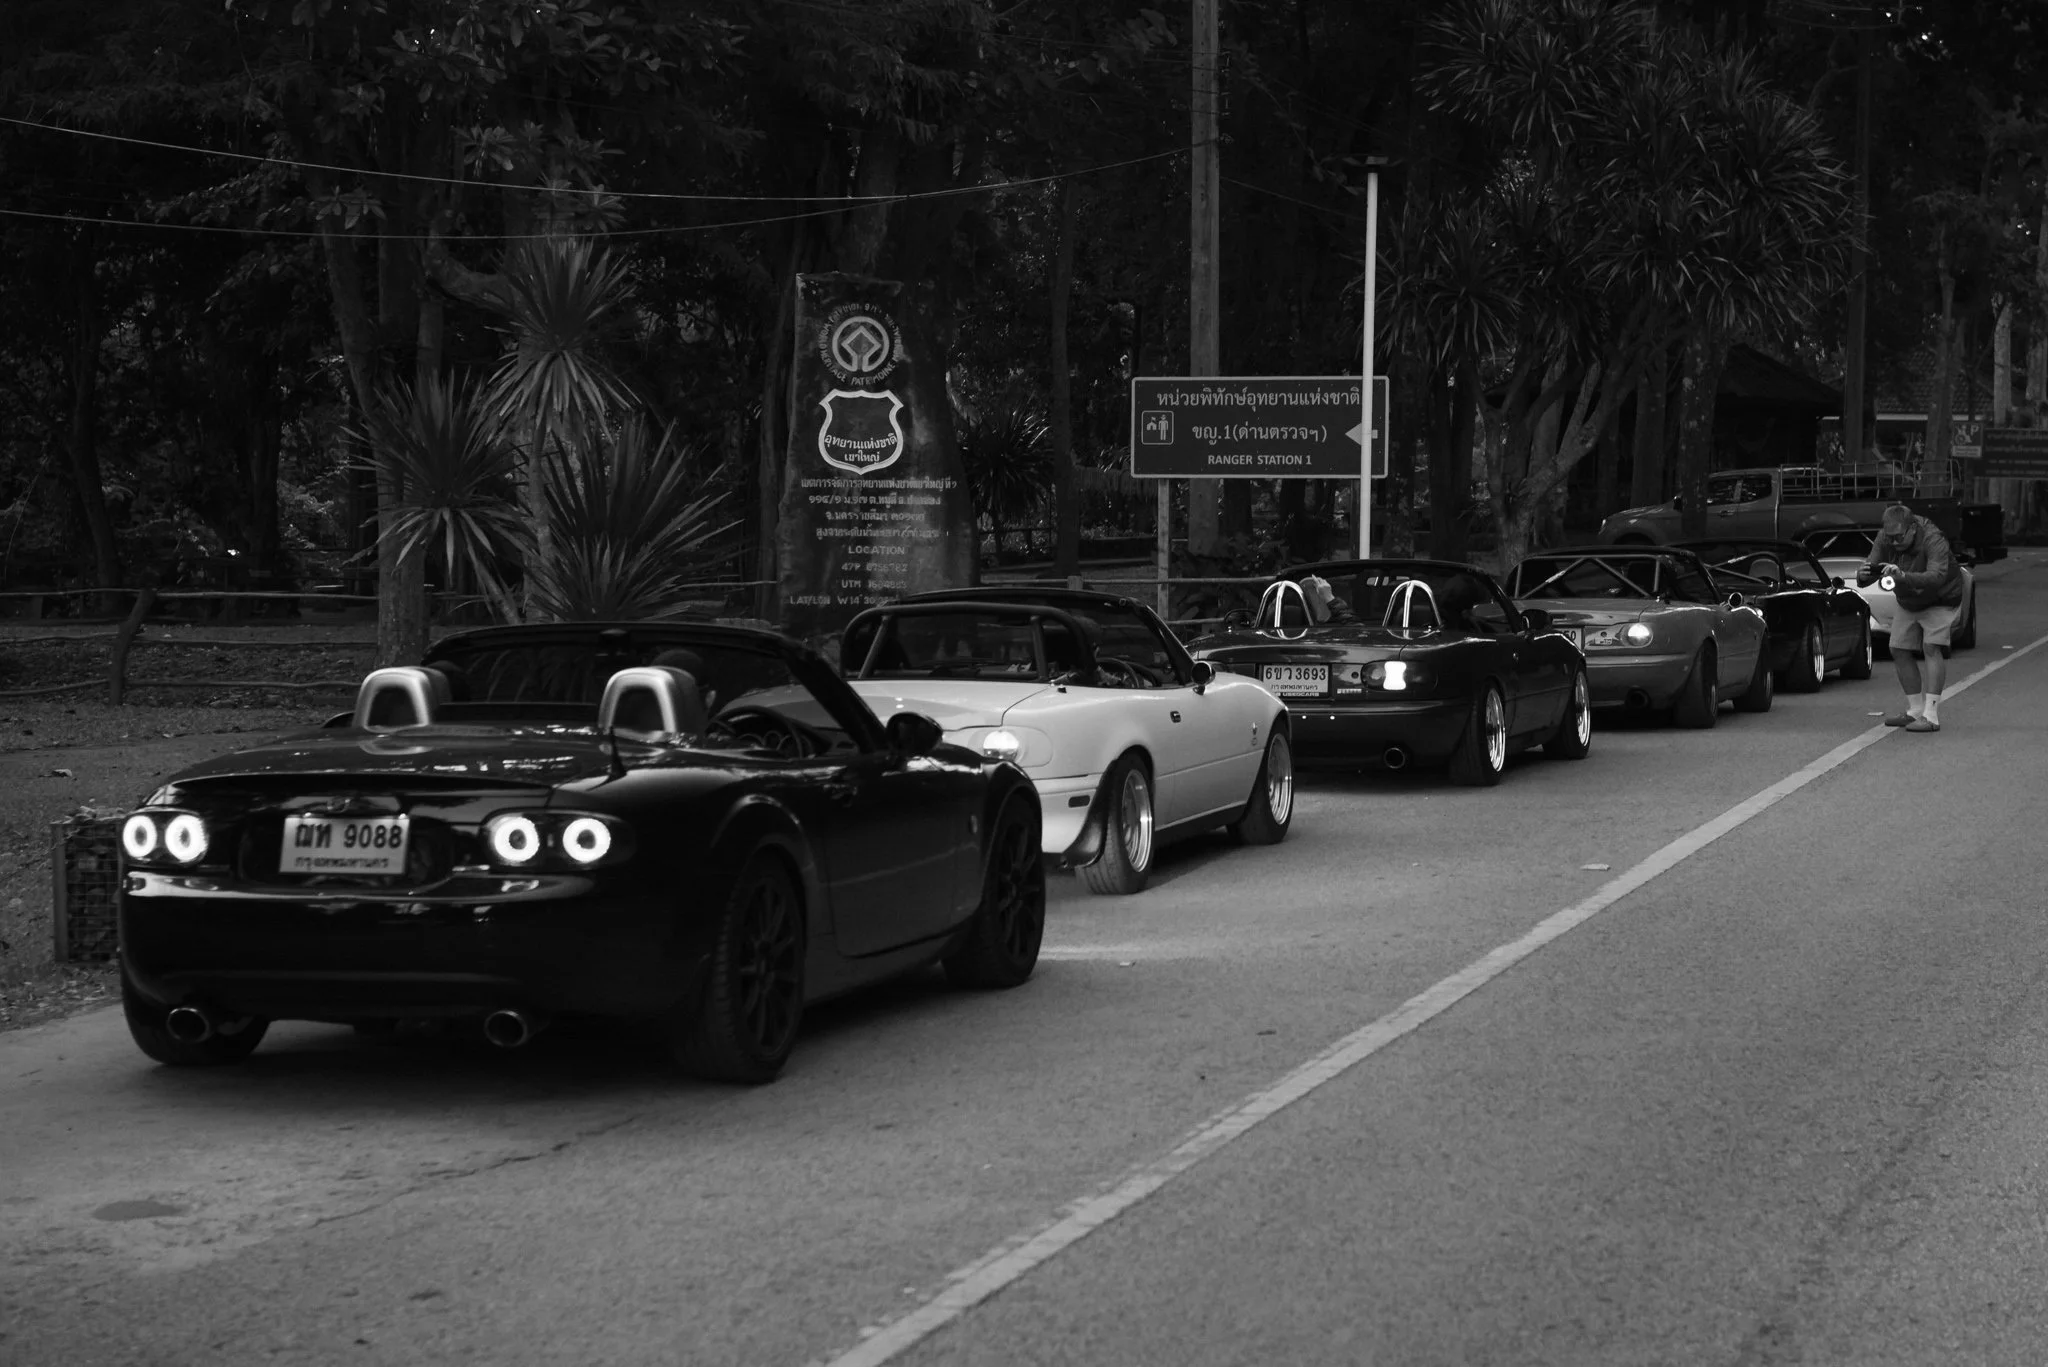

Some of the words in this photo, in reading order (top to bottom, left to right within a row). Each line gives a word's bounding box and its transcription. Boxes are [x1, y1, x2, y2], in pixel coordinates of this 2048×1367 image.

[1156, 386, 1360, 412] หน่วยพิทักษ์อุทยานแห่งชาติ
[824, 432, 898, 450] อุทยานแห่งชาติ
[844, 449, 880, 465] เขาใหญ่
[1207, 454, 1253, 465] RANGER
[1257, 454, 1303, 465] STATION
[1305, 454, 1312, 465] 1
[848, 545, 905, 555] LOCATION
[841, 580, 861, 589] UTM
[1295, 667, 1326, 681] 3693
[343, 823, 402, 849] 9088
